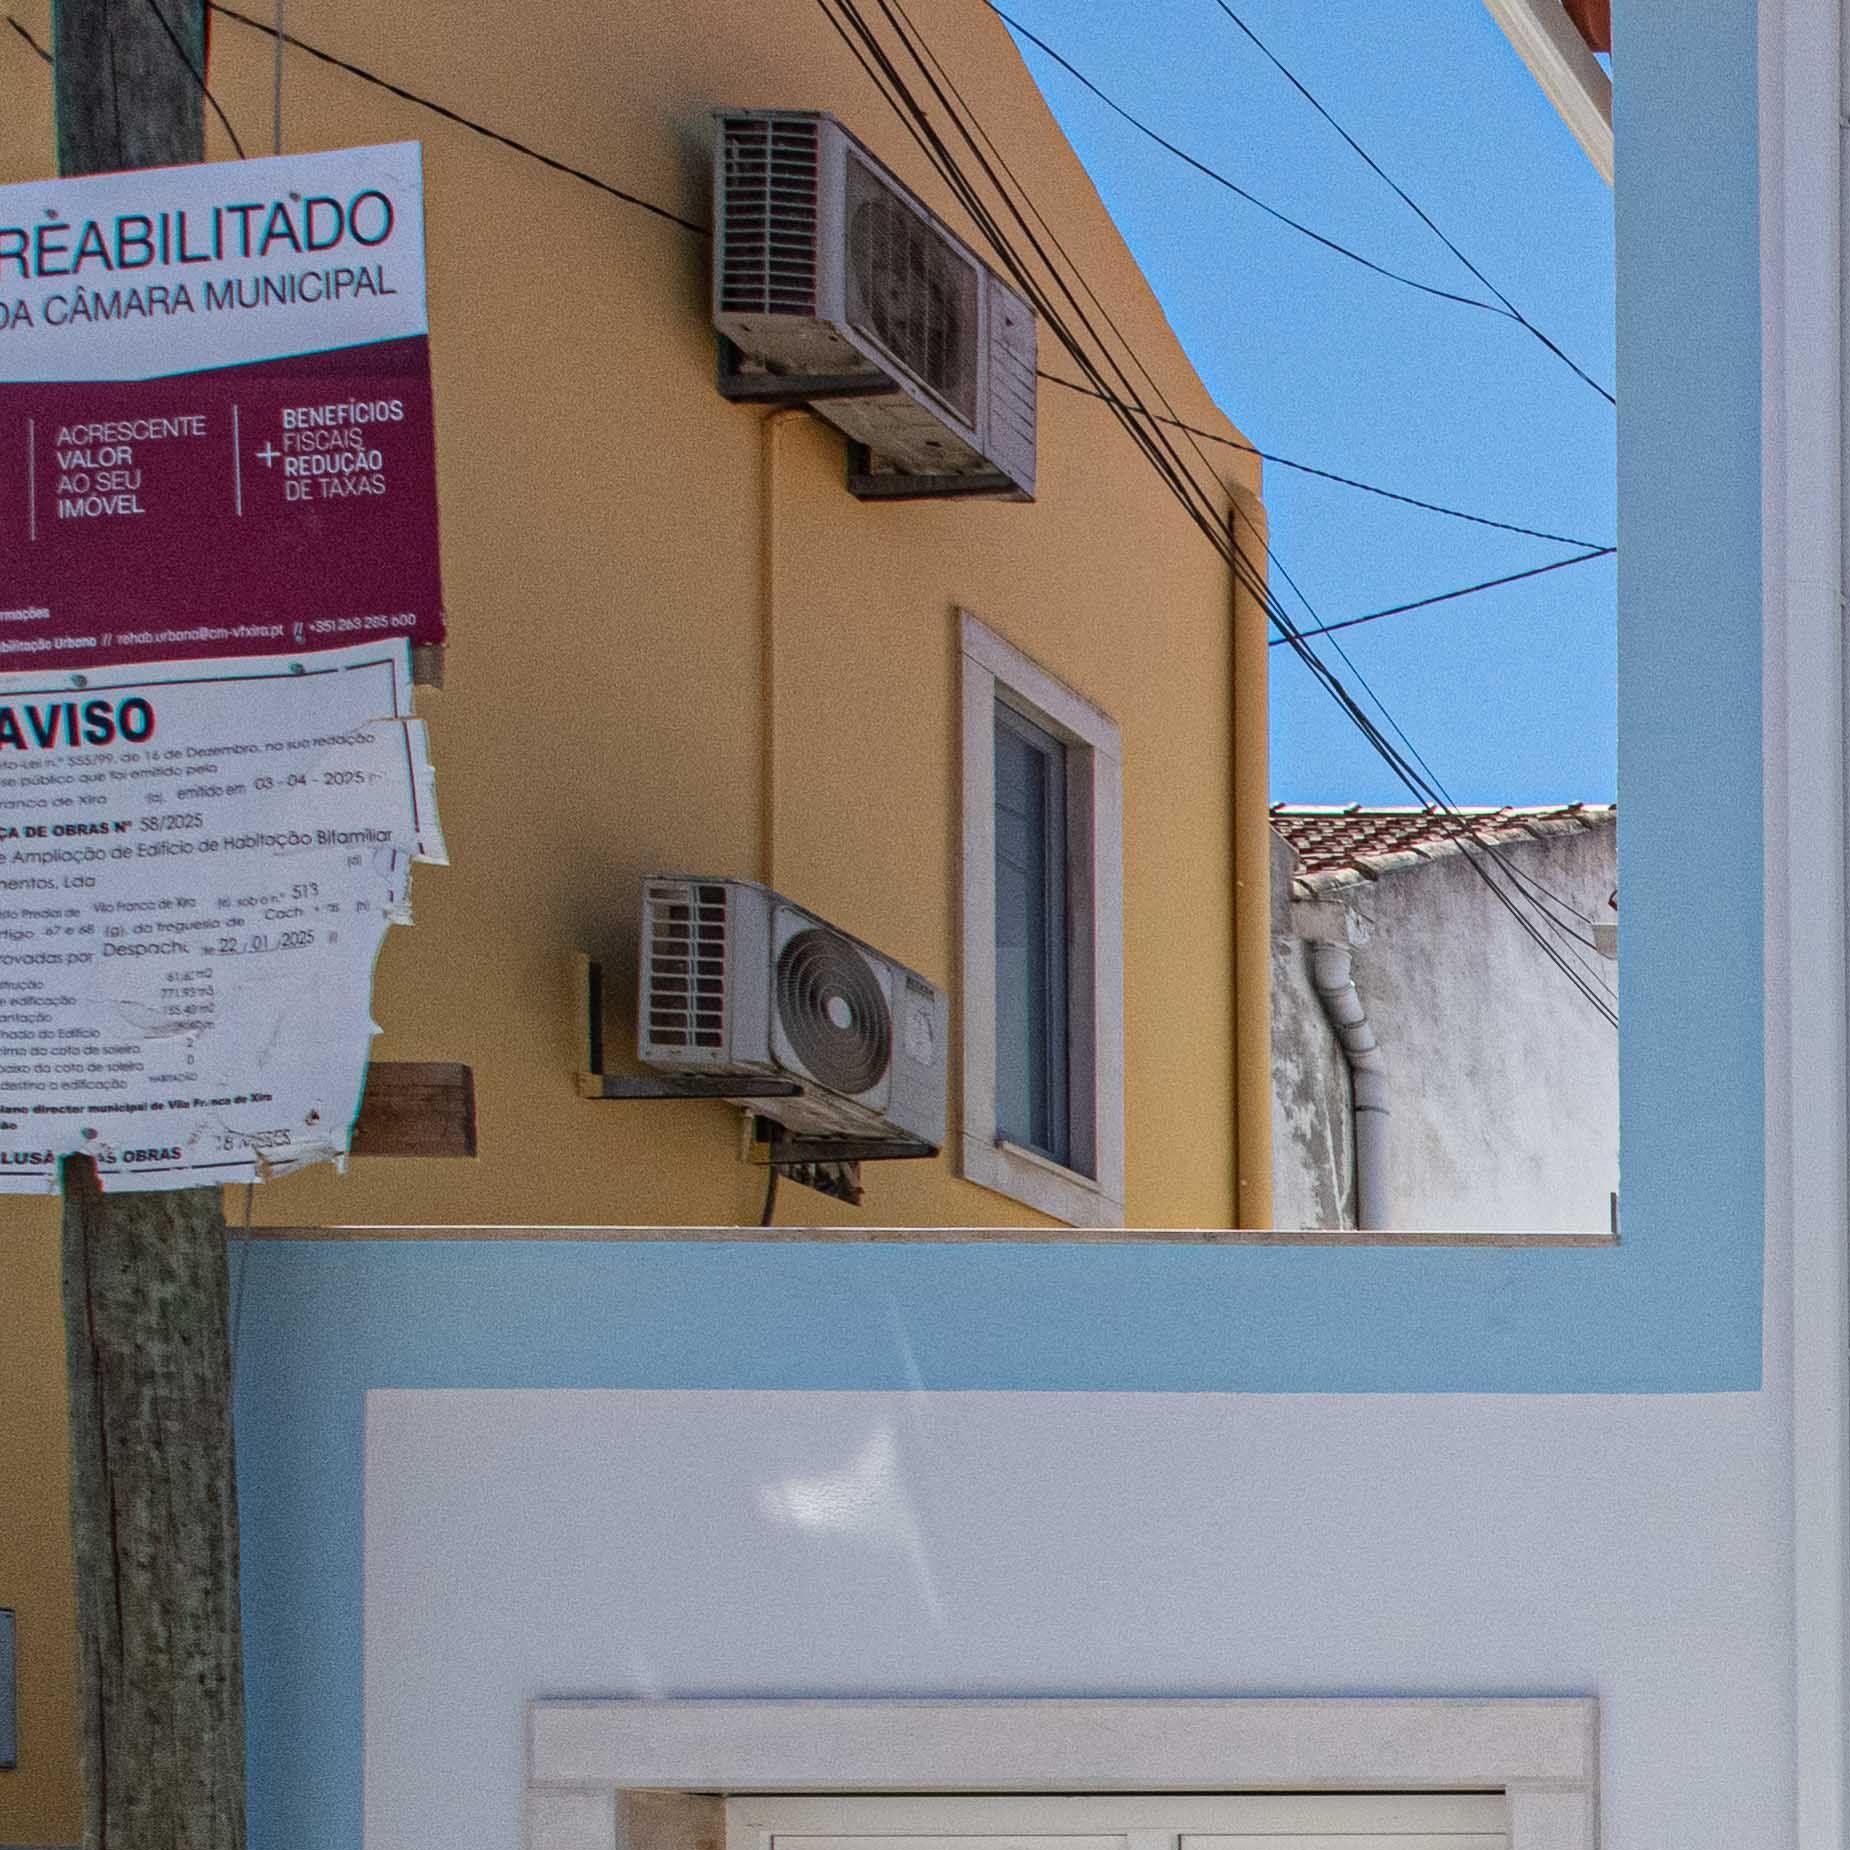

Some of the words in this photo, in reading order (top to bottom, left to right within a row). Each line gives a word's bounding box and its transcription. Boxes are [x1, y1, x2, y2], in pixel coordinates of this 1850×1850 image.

[0, 188, 396, 278] REABILITADO
[43, 283, 195, 326] CÂMARA
[205, 265, 397, 311] MUNICIPAL
[282, 399, 405, 429] BENEFÍCIOS
[57, 416, 206, 446] ACRESCENTE
[283, 428, 363, 451] FISCAIS
[57, 447, 133, 470] VALOR
[284, 447, 384, 477] REDUÇÃO
[57, 473, 91, 495] AO
[96, 470, 142, 492] SEU
[286, 480, 313, 501] DE
[319, 474, 386, 497] TAXAS
[58, 494, 145, 519] IMÓVEL
[54, 635, 98, 649] Urbana
[0, 697, 156, 750] AVISO
[25, 825, 48, 838] DE
[53, 822, 109, 837] OBRAS
[13, 846, 106, 866] Ampliação
[111, 845, 134, 859] de
[198, 838, 219, 852] de
[223, 830, 313, 849] Habitação
[122, 1146, 183, 1164] OBRAS
